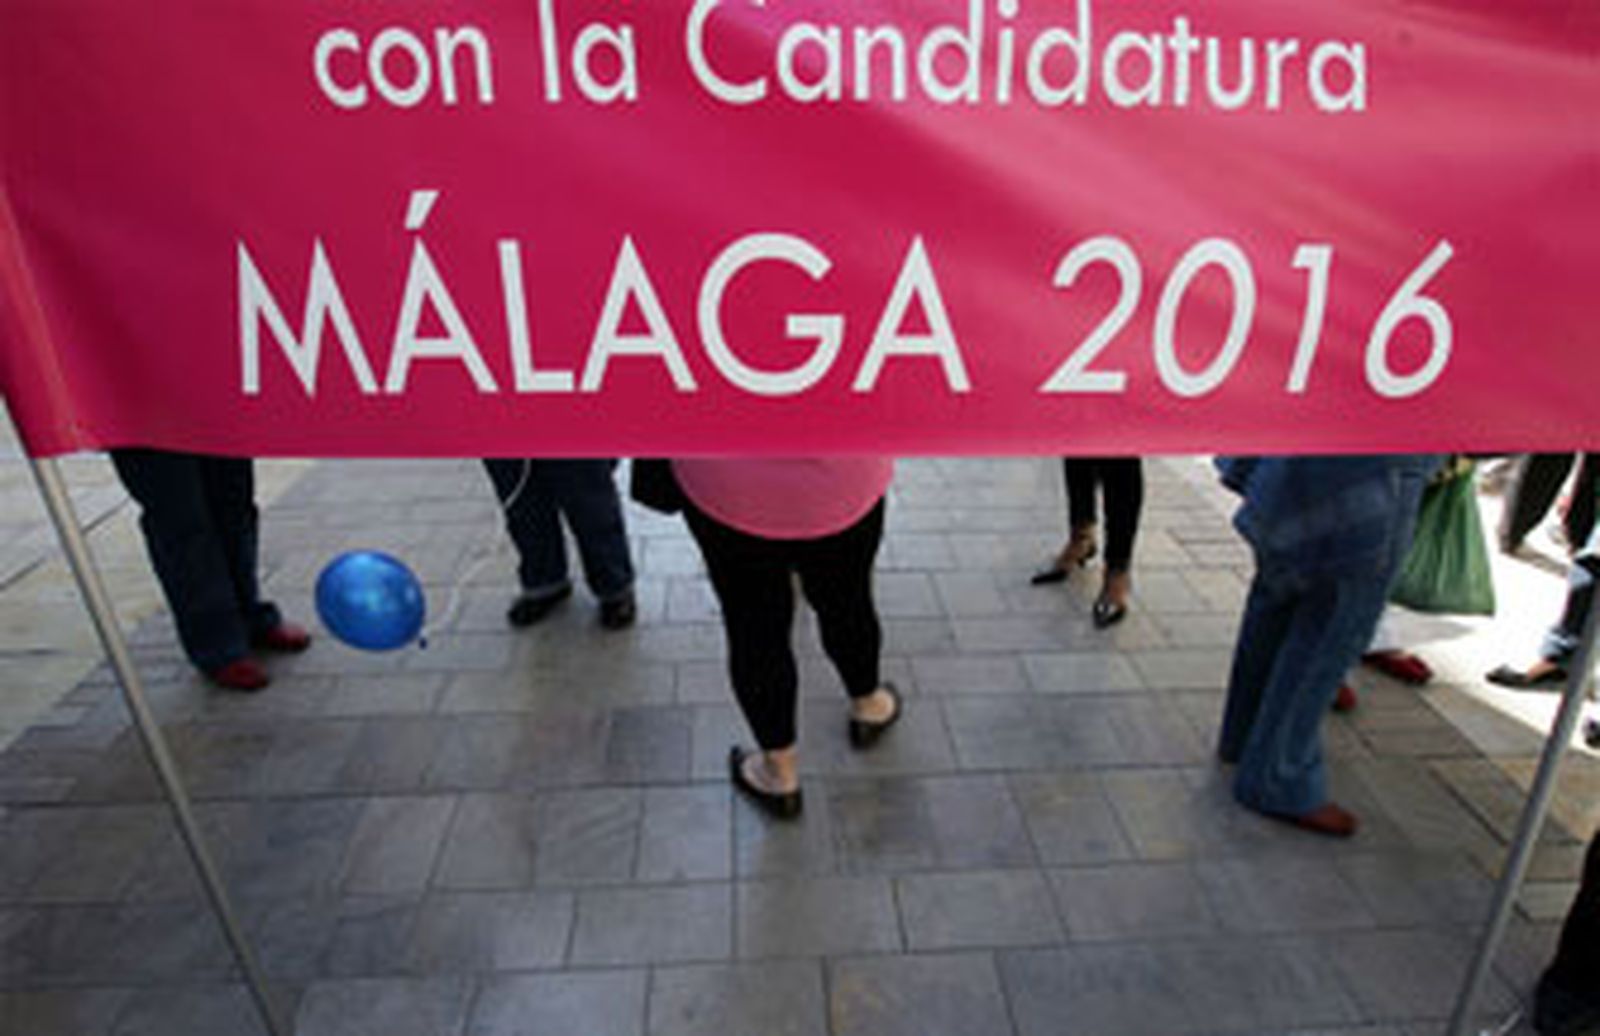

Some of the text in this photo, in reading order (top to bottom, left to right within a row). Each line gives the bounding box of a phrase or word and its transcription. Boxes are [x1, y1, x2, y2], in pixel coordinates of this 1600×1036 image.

[314, 0, 1367, 112] con la Candidatura
[238, 190, 1454, 398] MÁLAGA 2016
